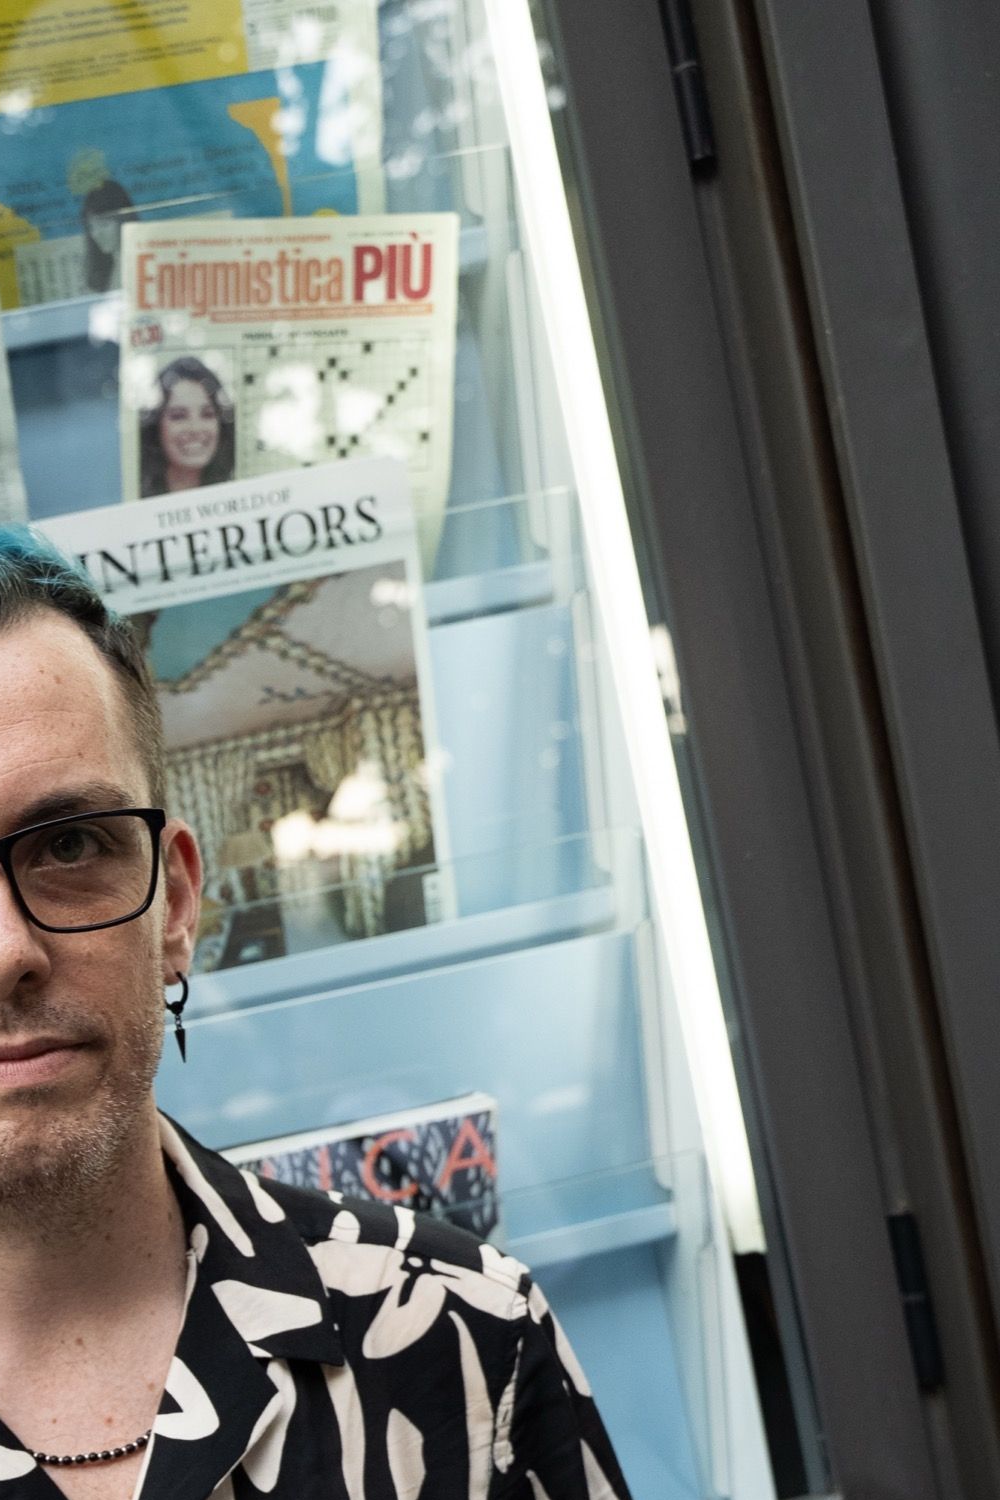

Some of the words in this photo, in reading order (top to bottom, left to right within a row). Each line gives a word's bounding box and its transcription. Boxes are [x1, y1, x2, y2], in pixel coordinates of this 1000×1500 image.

[136, 249, 344, 319] Enigmistica
[353, 231, 433, 303] PIÙ
[80, 495, 384, 594] NTERIORS
[156, 507, 192, 529] THE
[197, 494, 263, 519] WORLD
[261, 1118, 496, 1201] ICA
